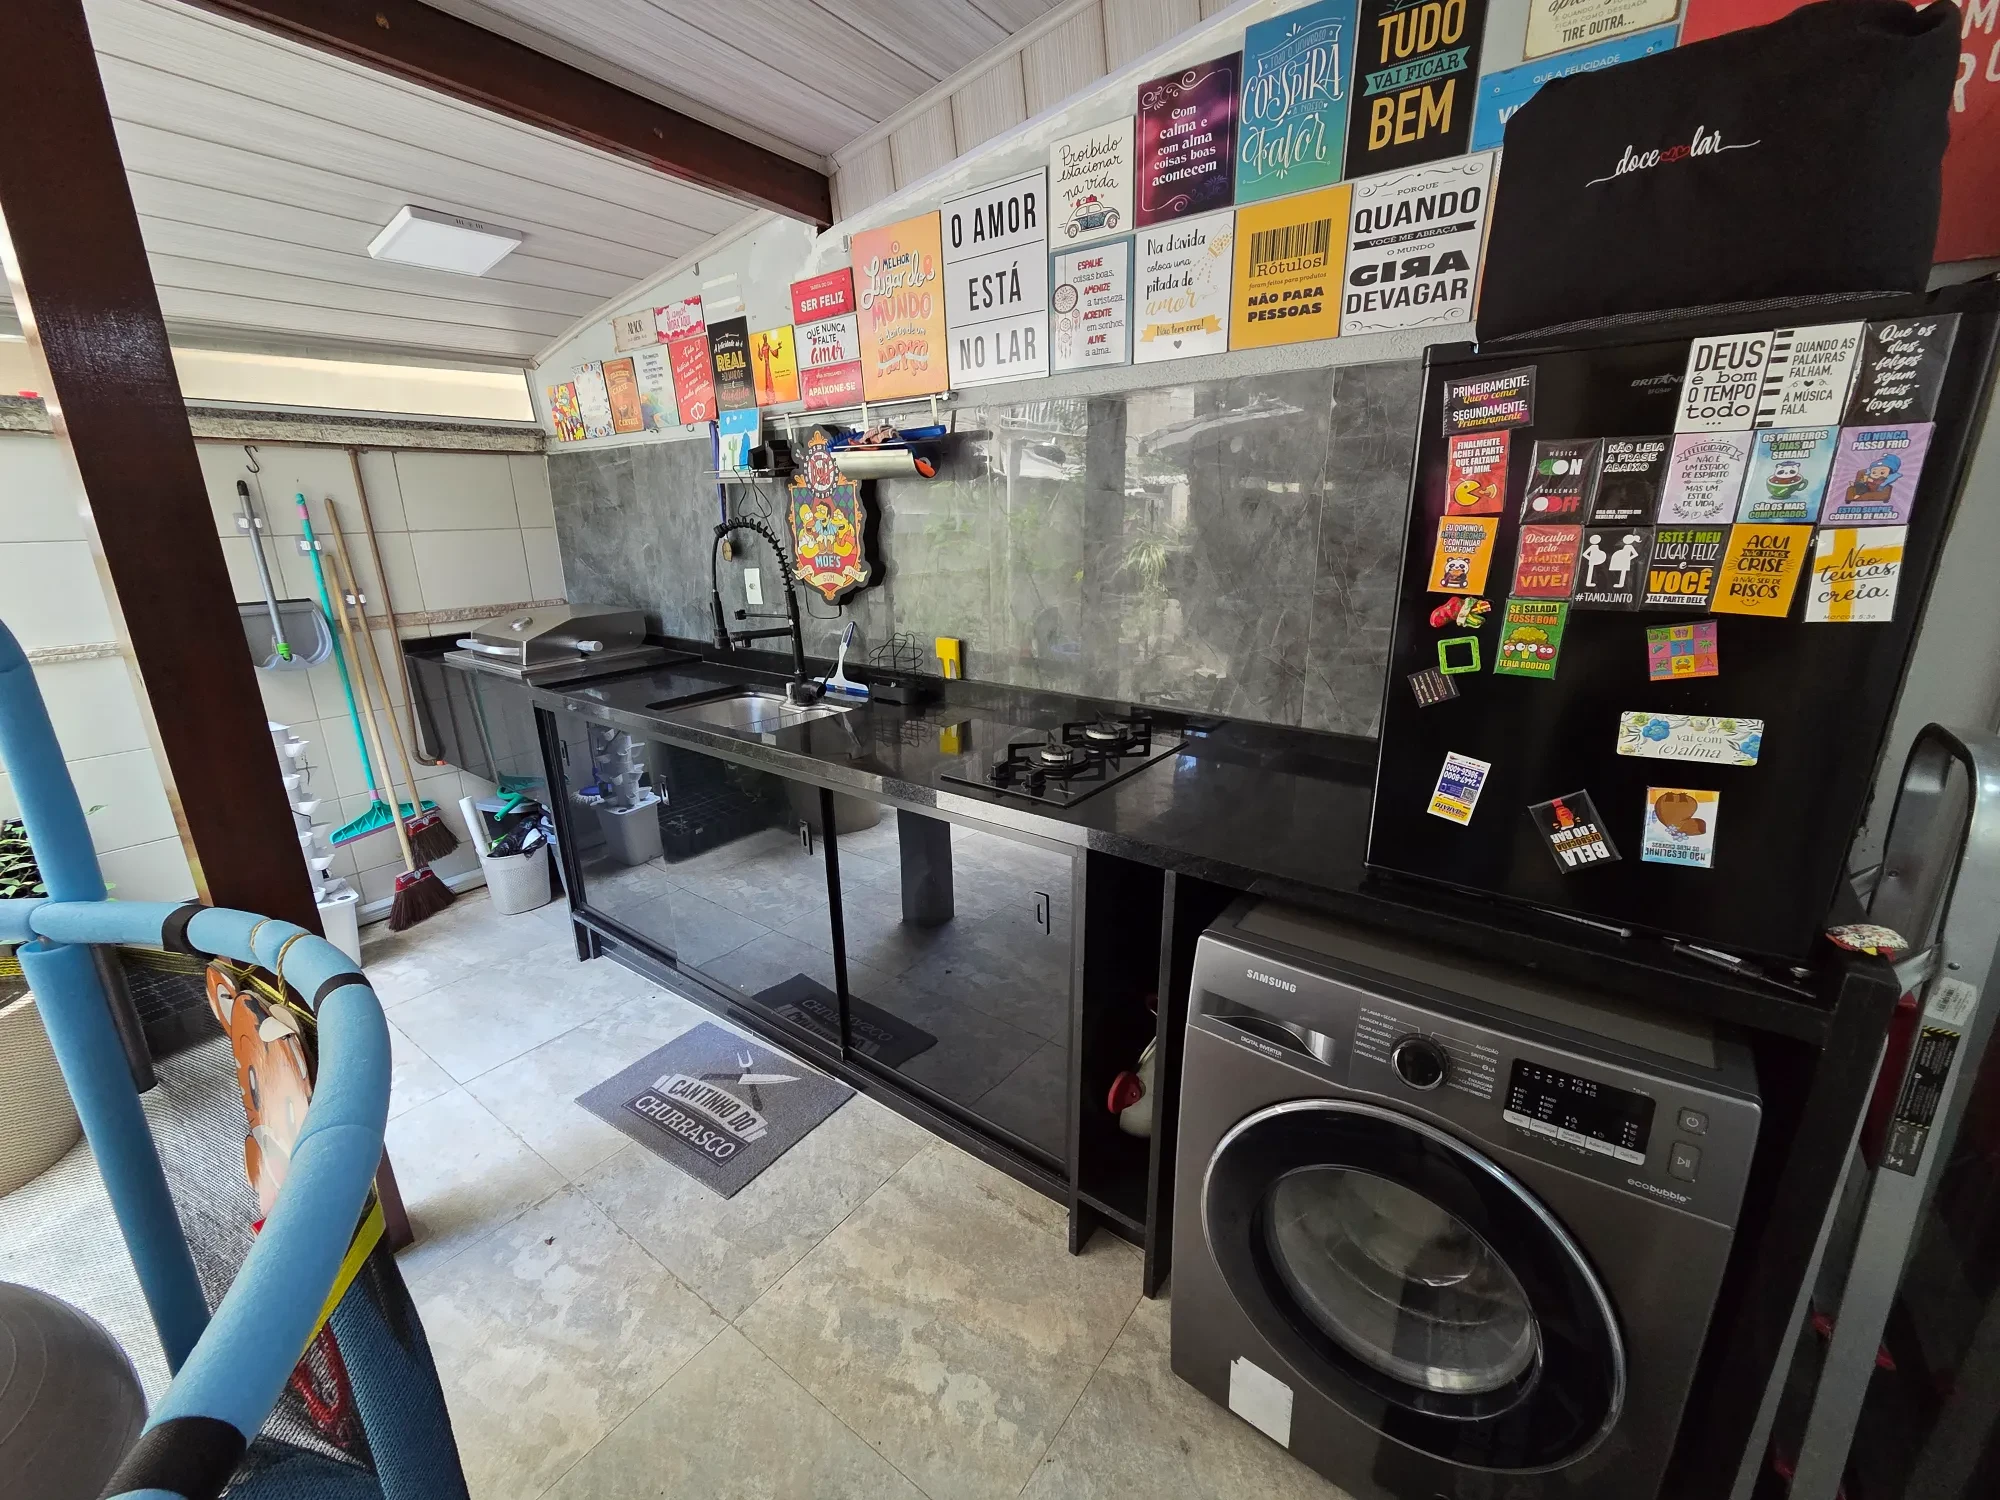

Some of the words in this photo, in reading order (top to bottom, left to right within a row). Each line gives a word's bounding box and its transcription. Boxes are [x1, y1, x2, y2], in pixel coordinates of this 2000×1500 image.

[1377, 0, 1468, 64] TUDO
[1562, 24, 1586, 43] TIRE
[1373, 65, 1403, 91] VAI
[1405, 52, 1460, 83] FICAR
[1533, 72, 1554, 84] QUE
[1565, 53, 1621, 76] FELICIDADE
[1241, 43, 1344, 125] CONSPIRA
[1171, 105, 1197, 120] Com
[1368, 78, 1456, 151] BEM
[1159, 120, 1197, 140] calma
[1200, 118, 1208, 127] e
[1058, 134, 1123, 167] Proibido
[1157, 142, 1179, 156] com
[1182, 131, 1213, 150] alma
[1153, 152, 1187, 171] coisas
[1190, 145, 1217, 161] boas
[1600, 144, 1661, 181] doce
[1690, 125, 1738, 158] lar
[1056, 154, 1123, 183] estacionar
[1151, 159, 1218, 187] acontecem
[1062, 184, 1085, 201] na
[1085, 171, 1119, 191] vida
[1397, 181, 1440, 196] PORQUE
[1354, 186, 1482, 234] QUANDO
[950, 212, 963, 249] O
[973, 191, 1037, 244] AMOR
[1147, 238, 1163, 256] Na
[1165, 228, 1206, 252] dúvida
[1369, 234, 1397, 247] VOCÊ
[1398, 232, 1414, 243] ME
[1416, 224, 1458, 240] ABRAÇA
[1396, 242, 1435, 255] MUNDO
[882, 252, 910, 272] MELHOR
[1077, 257, 1104, 271] ESPALHE
[1256, 256, 1322, 278] Rótulos
[861, 255, 906, 311] Lugar
[968, 260, 1022, 312] ESTÁ
[1083, 282, 1112, 296] AMENIZE
[1146, 273, 1179, 300] pitada
[1181, 270, 1194, 286] de
[800, 298, 818, 313] SER
[819, 290, 845, 308] FELIZ
[1145, 286, 1199, 316] amor
[1248, 291, 1279, 307] NÃO
[1282, 285, 1324, 302] PARA
[1346, 277, 1469, 315] DEVAGAR
[872, 291, 933, 333] MUNDO
[1082, 307, 1112, 321] ACREDITE
[1248, 302, 1322, 323] PESSOAS
[806, 326, 821, 340] QUE
[821, 322, 846, 334] NUNCA
[817, 333, 837, 345] FALTE
[1879, 324, 1913, 344] Que
[810, 340, 846, 365] amor
[959, 334, 986, 372] NO
[996, 326, 1038, 365] LAR
[1795, 338, 1838, 353] QUANDO
[1840, 337, 1856, 350] AS
[1886, 340, 1920, 355] dias
[716, 350, 747, 372] REAL
[1693, 339, 1767, 373] DEUS
[1791, 350, 1847, 366] PALAVRAS
[1875, 353, 1923, 371] felizes
[1716, 370, 1758, 384] bom
[1789, 364, 1833, 379] FALHAM.
[1873, 370, 1917, 387] sejam
[808, 381, 856, 397] APAIXONE-SE
[1452, 374, 1530, 399] PRIMEIRAMENTE:
[1687, 386, 1698, 403] O
[1703, 383, 1757, 402] TEMPO
[1782, 392, 1791, 403] A
[1792, 386, 1833, 402] MÚSICA
[1874, 383, 1911, 397] mais
[1462, 393, 1489, 405] Quero
[1490, 387, 1519, 399] comer
[1452, 399, 1529, 422] SEGUNDAMENTE:
[1686, 401, 1751, 420] todo
[1780, 403, 1808, 416] FALA.
[1865, 397, 1914, 414] longos
[1457, 412, 1523, 429] Primeiramente
[1457, 437, 1501, 450] FINALMENTE
[1762, 433, 1776, 443] OS
[1776, 430, 1828, 442] PRIMEIROS
[1873, 429, 1909, 441] NUNCA
[1452, 448, 1474, 459] ACHEI
[1481, 445, 1505, 455] PARTE
[1608, 441, 1634, 453] NÃO
[1636, 442, 1665, 452] LEIA
[1687, 444, 1732, 456] FELICIDADE
[1801, 440, 1816, 449] DA
[1852, 441, 1886, 450] PASSO
[1886, 439, 1910, 449] FRIO
[1455, 458, 1470, 467] QUE
[1470, 455, 1500, 465] FALTAVA
[1617, 452, 1658, 462] FRASE
[1772, 450, 1810, 460] SEMANA
[1603, 462, 1650, 473] ABAIXO
[1783, 502, 1806, 511] MAIS
[1525, 531, 1577, 545] Desculpa
[1657, 531, 1685, 543] ESTE
[1695, 531, 1722, 544] MEU
[1746, 534, 1791, 550] AQUI
[1535, 543, 1559, 556] pela
[1654, 543, 1689, 560] LUGAR
[1690, 543, 1720, 561] FELIZ
[1839, 544, 1883, 571] Não
[814, 555, 841, 568] MOE'S
[1531, 565, 1550, 573] AQUI
[1737, 558, 1787, 573] CRISE
[1520, 573, 1570, 588] VIVE!
[1649, 567, 1714, 594] VOCÊ
[1575, 592, 1634, 604] #TAMOJUNTO
[1662, 595, 1686, 603] PARTE
[1729, 583, 1780, 599] RISOS
[1817, 584, 1890, 604] creia.
[1509, 604, 1521, 614] SE
[1524, 604, 1558, 613] SALADA
[1508, 613, 1536, 624] FOSSE
[1676, 733, 1694, 743] vai
[1696, 735, 1722, 745] com
[1658, 742, 1722, 759] (c)alma
[1549, 830, 1574, 844] BAR
[1572, 825, 1589, 838] DO
[1559, 841, 1611, 867] BELA
[1246, 968, 1297, 993] SAMSUNG
[1240, 1035, 1259, 1048] DIGITAL
[1259, 1043, 1282, 1057] INVERTER
[667, 1078, 742, 1126] CANTINHO
[732, 1110, 758, 1133] DO
[634, 1095, 736, 1159] CHURRASCO
[1626, 1177, 1687, 1203] ecobubble
